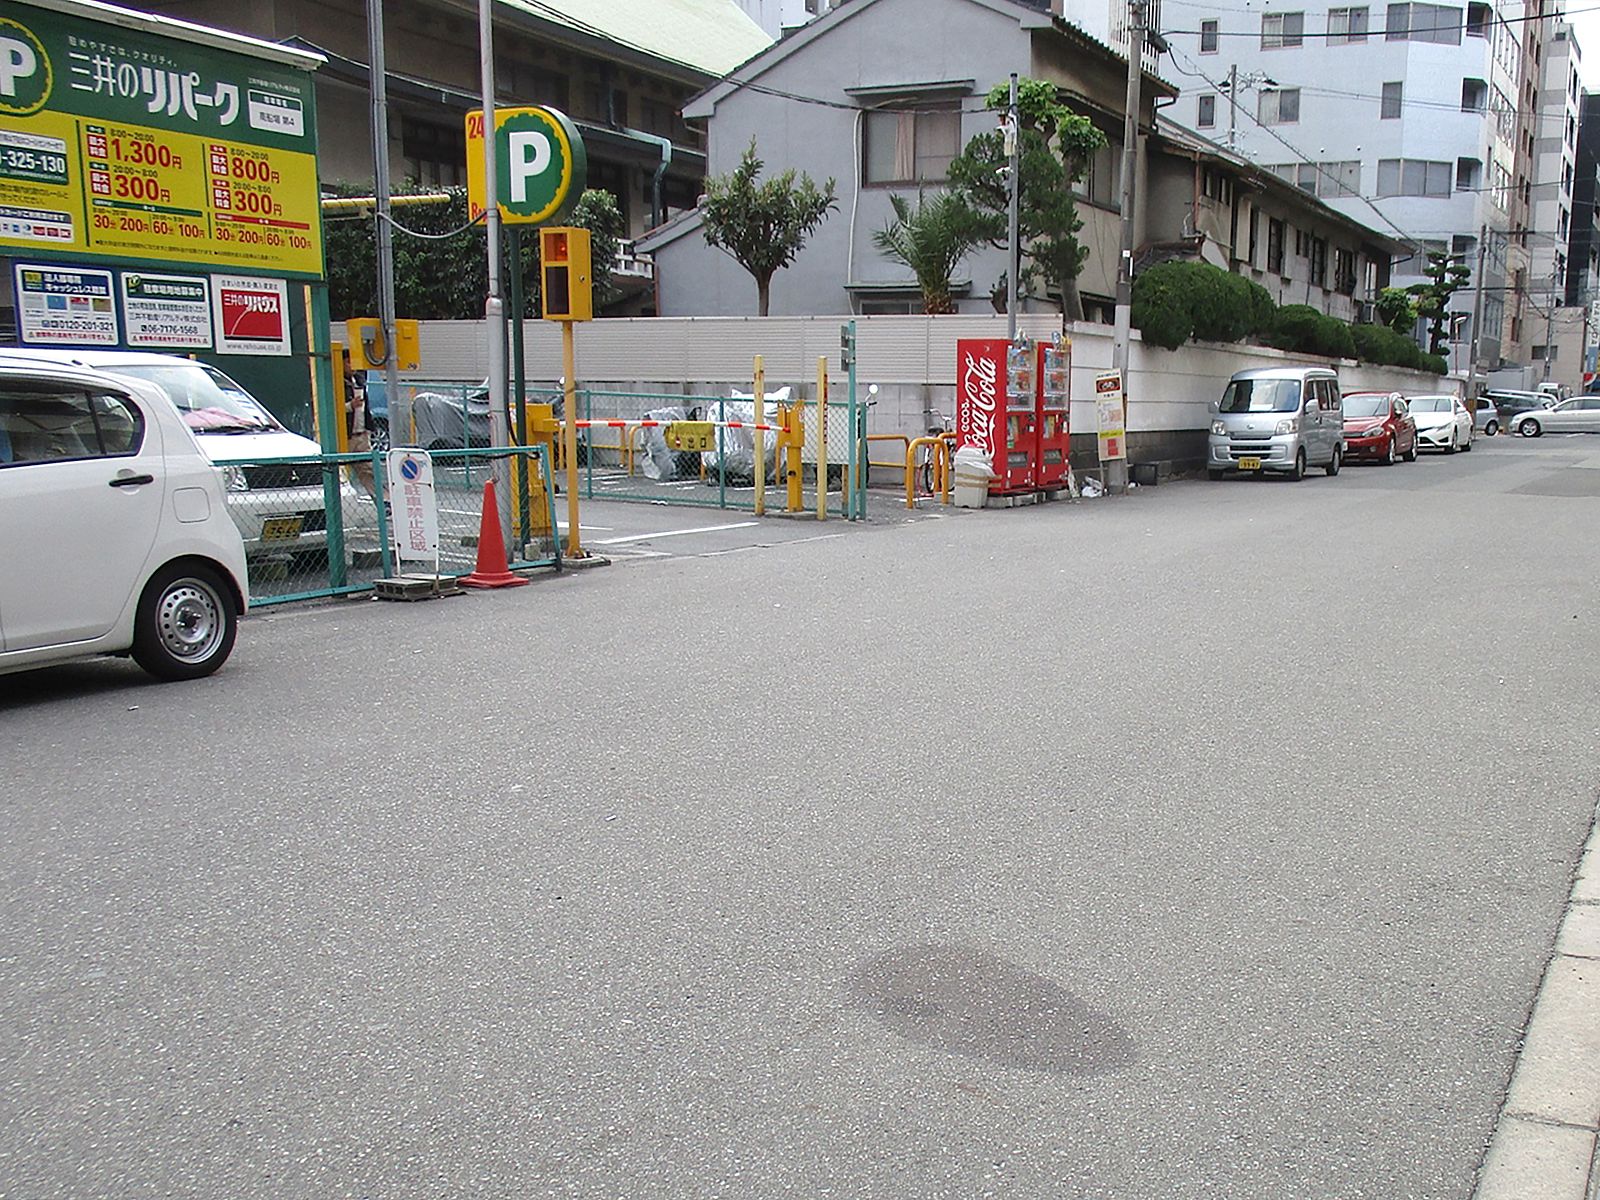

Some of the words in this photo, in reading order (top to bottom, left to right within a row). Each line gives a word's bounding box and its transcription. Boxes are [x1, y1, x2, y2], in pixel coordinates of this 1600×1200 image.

[0, 36, 37, 97] P
[69, 52, 239, 126] 三井のリパーク
[0, 149, 66, 174] -325-130
[232, 157, 280, 184] 800円
[509, 131, 551, 203] P
[115, 174, 170, 203] 300円
[234, 190, 282, 216] 300円
